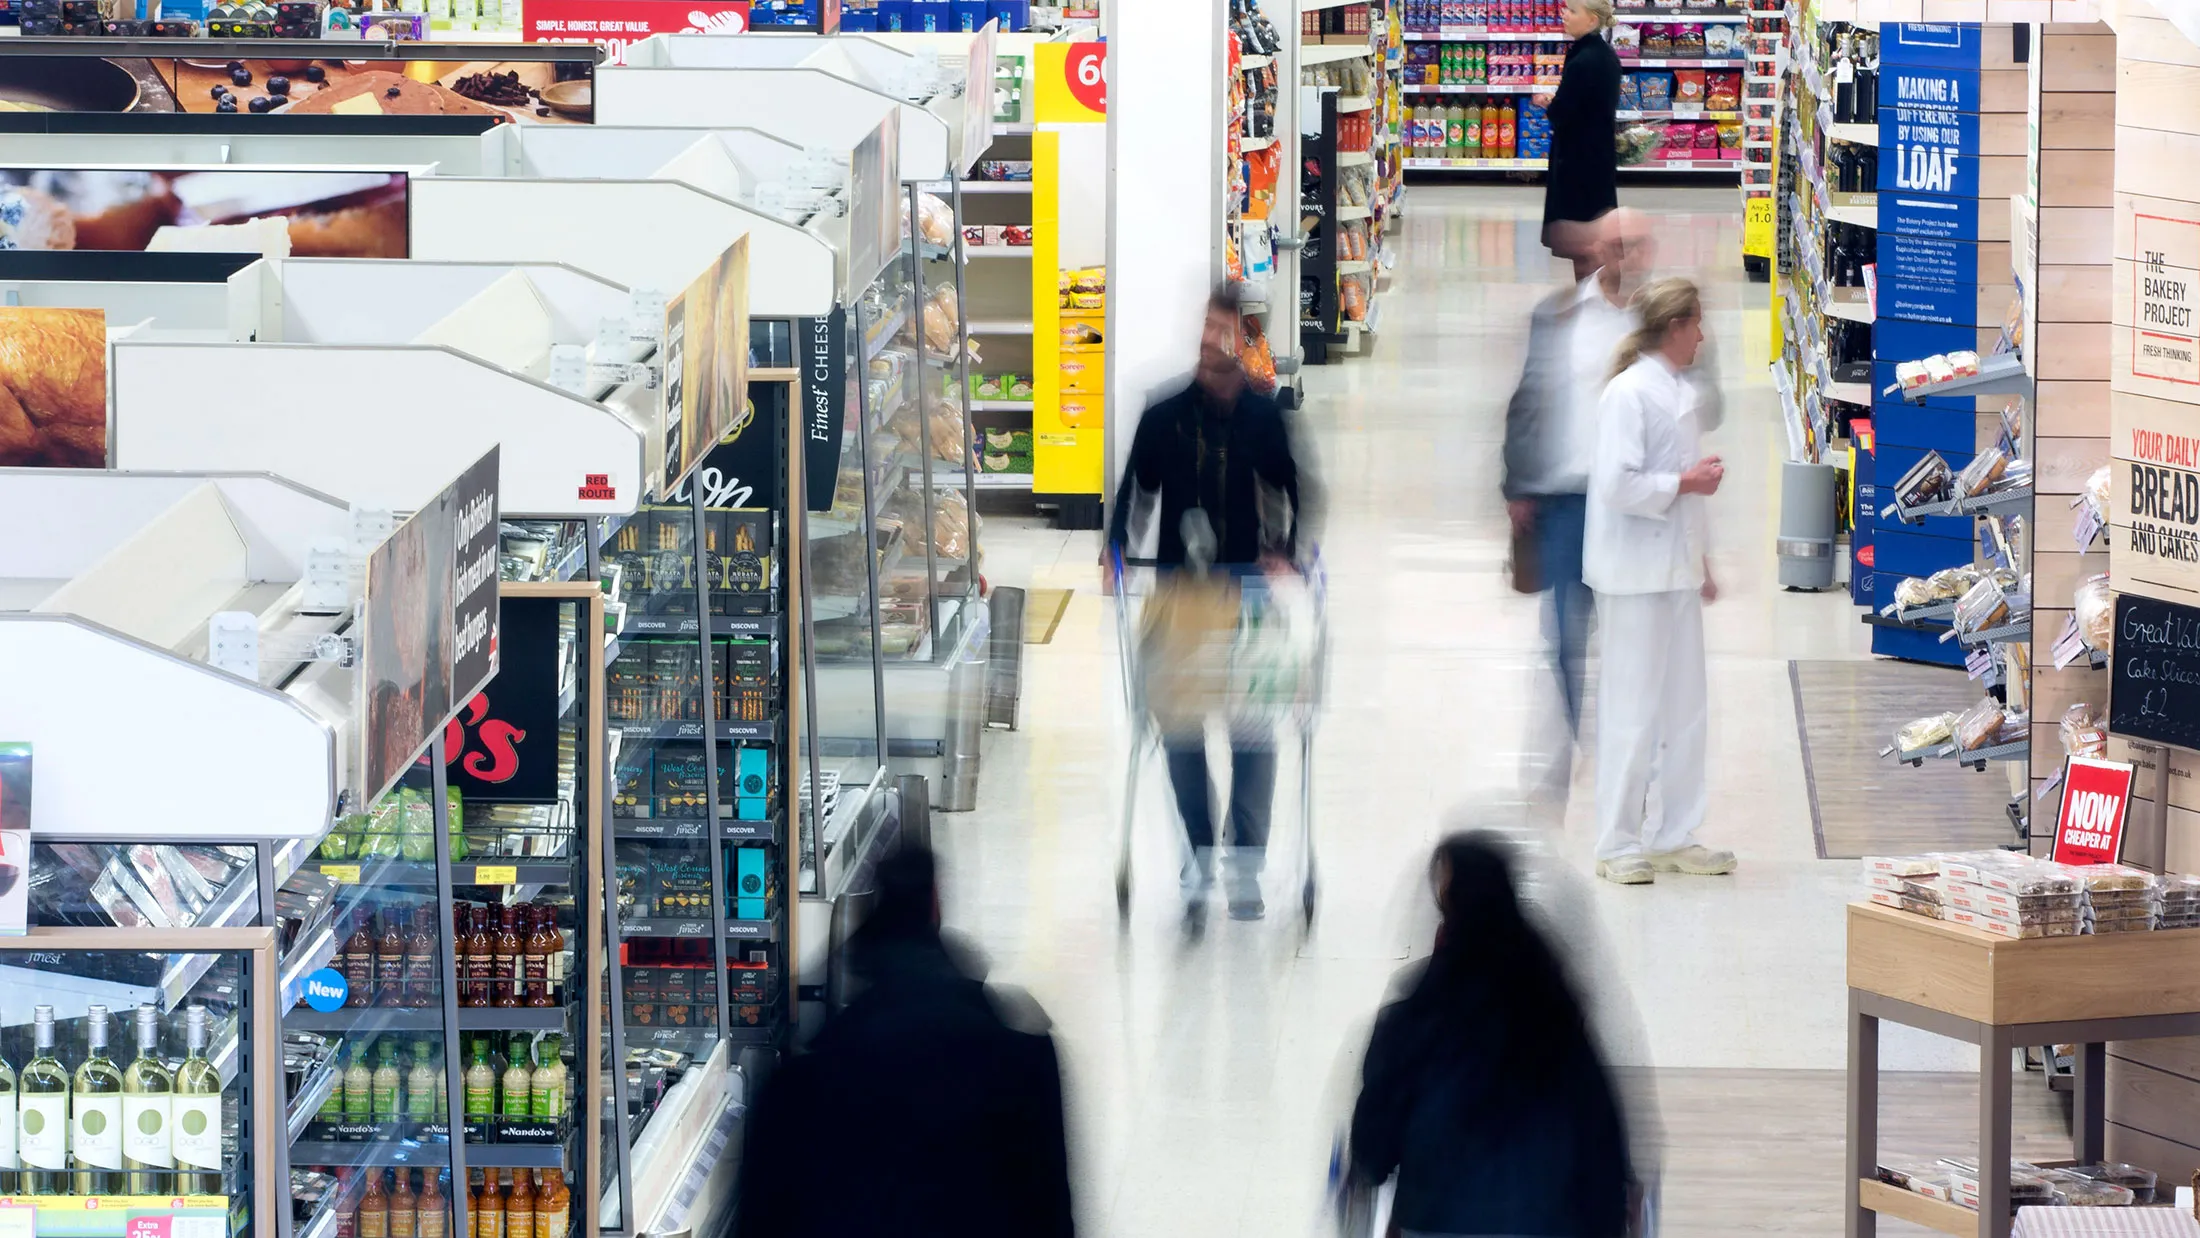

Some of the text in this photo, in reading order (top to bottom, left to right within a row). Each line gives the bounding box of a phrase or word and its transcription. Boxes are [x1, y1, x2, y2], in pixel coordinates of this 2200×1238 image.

[536, 20, 650, 32] SIMPLE, HONEST, GREAT VALUE.
[1908, 24, 1952, 34] FRESH THINKING
[1898, 76, 1959, 102] MAKING A
[1897, 102, 1959, 126] DIFFERENCE
[1898, 125, 1959, 146] BY USING OUR
[1896, 144, 1959, 192] LOAF
[2145, 251, 2165, 274] THE
[2144, 278, 2187, 302] BAKERY
[2144, 302, 2191, 328] PROJECT
[2143, 344, 2192, 362] FRESH THINKING
[811, 384, 829, 442] Finest
[2132, 428, 2200, 468] YOUR DAILY
[586, 476, 608, 486] RED
[579, 489, 615, 499] ROUTE
[2130, 463, 2199, 526] BREAD
[2131, 520, 2199, 563] AND CAKES
[2123, 606, 2173, 645] Great
[2127, 657, 2200, 685] Cake Slices
[676, 725, 703, 737] finest
[2067, 789, 2120, 833] NOW
[674, 825, 702, 836] finest
[2064, 828, 2112, 851] CHEAPER AT
[677, 924, 704, 936] finest
[308, 980, 344, 999] New
[652, 1030, 680, 1041] finest
[508, 1127, 546, 1137] Nando's
[137, 1221, 159, 1230] Extra
